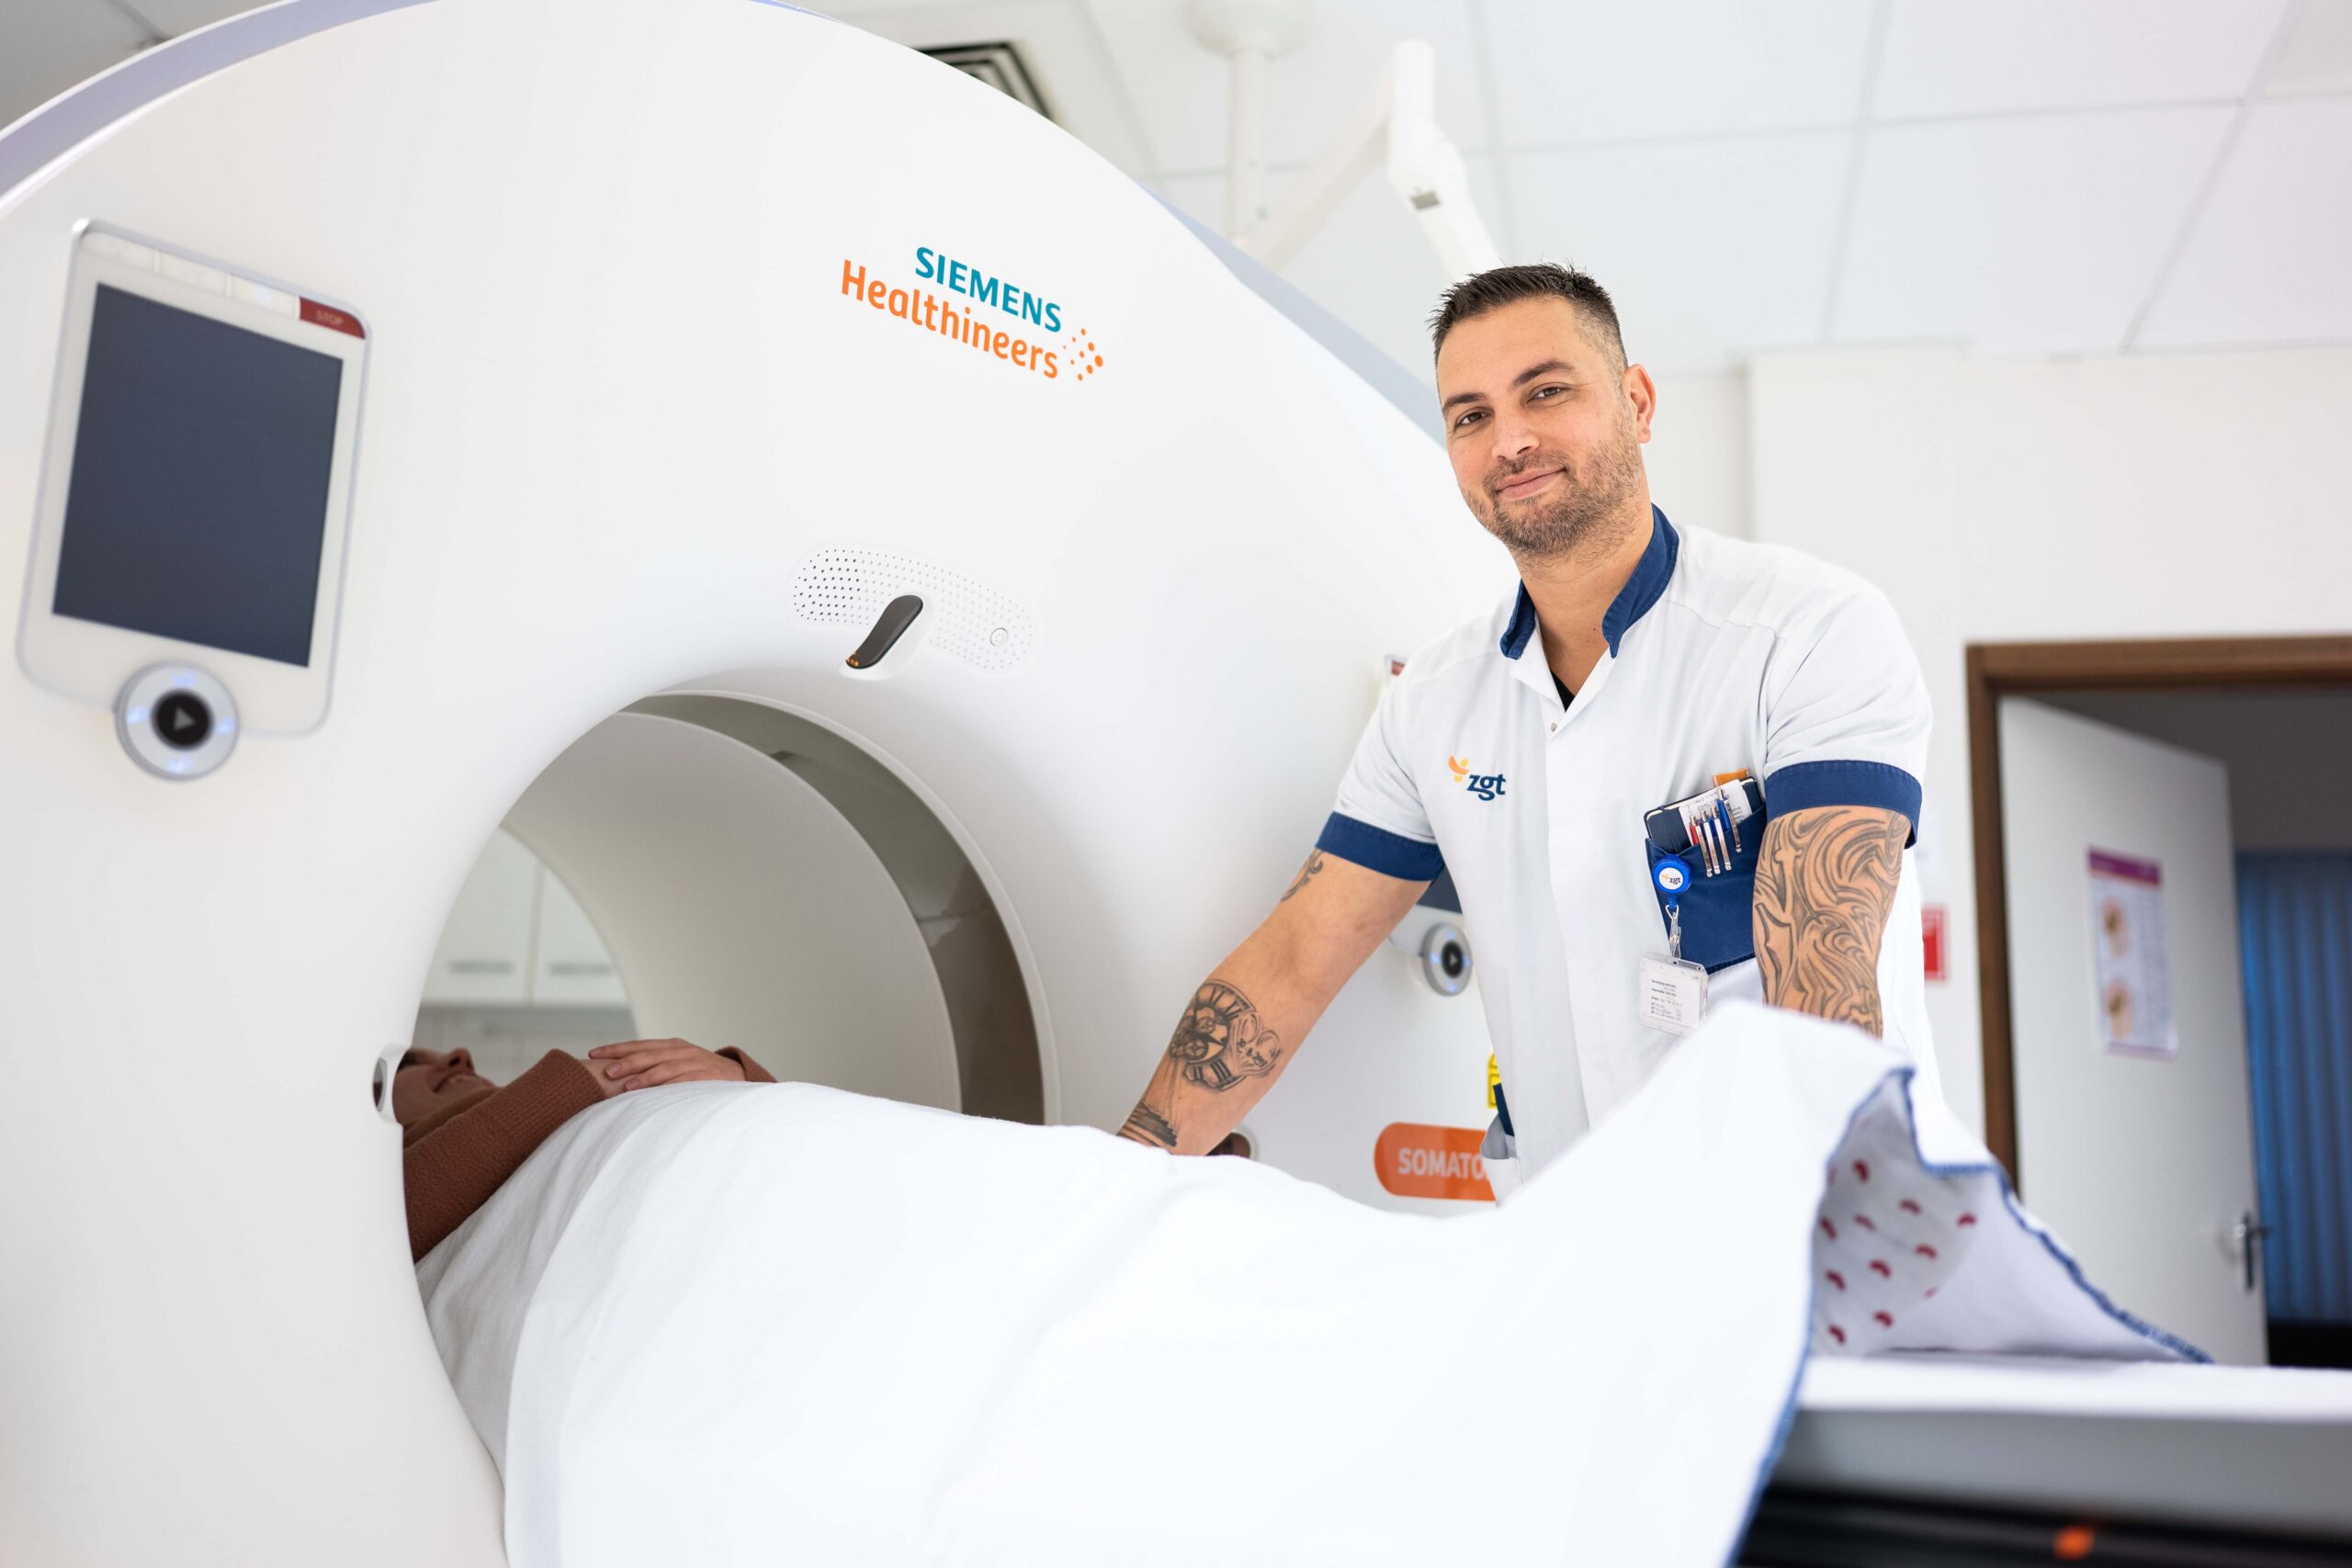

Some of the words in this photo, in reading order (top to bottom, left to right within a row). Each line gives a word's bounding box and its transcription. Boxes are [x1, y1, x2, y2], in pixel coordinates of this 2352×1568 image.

[915, 246, 1061, 333] SIEMENS
[316, 310, 344, 325] STOP
[842, 259, 1057, 378] Healthineers
[1467, 773, 1507, 801] zgt
[1397, 1147, 1488, 1180] SOMATO
